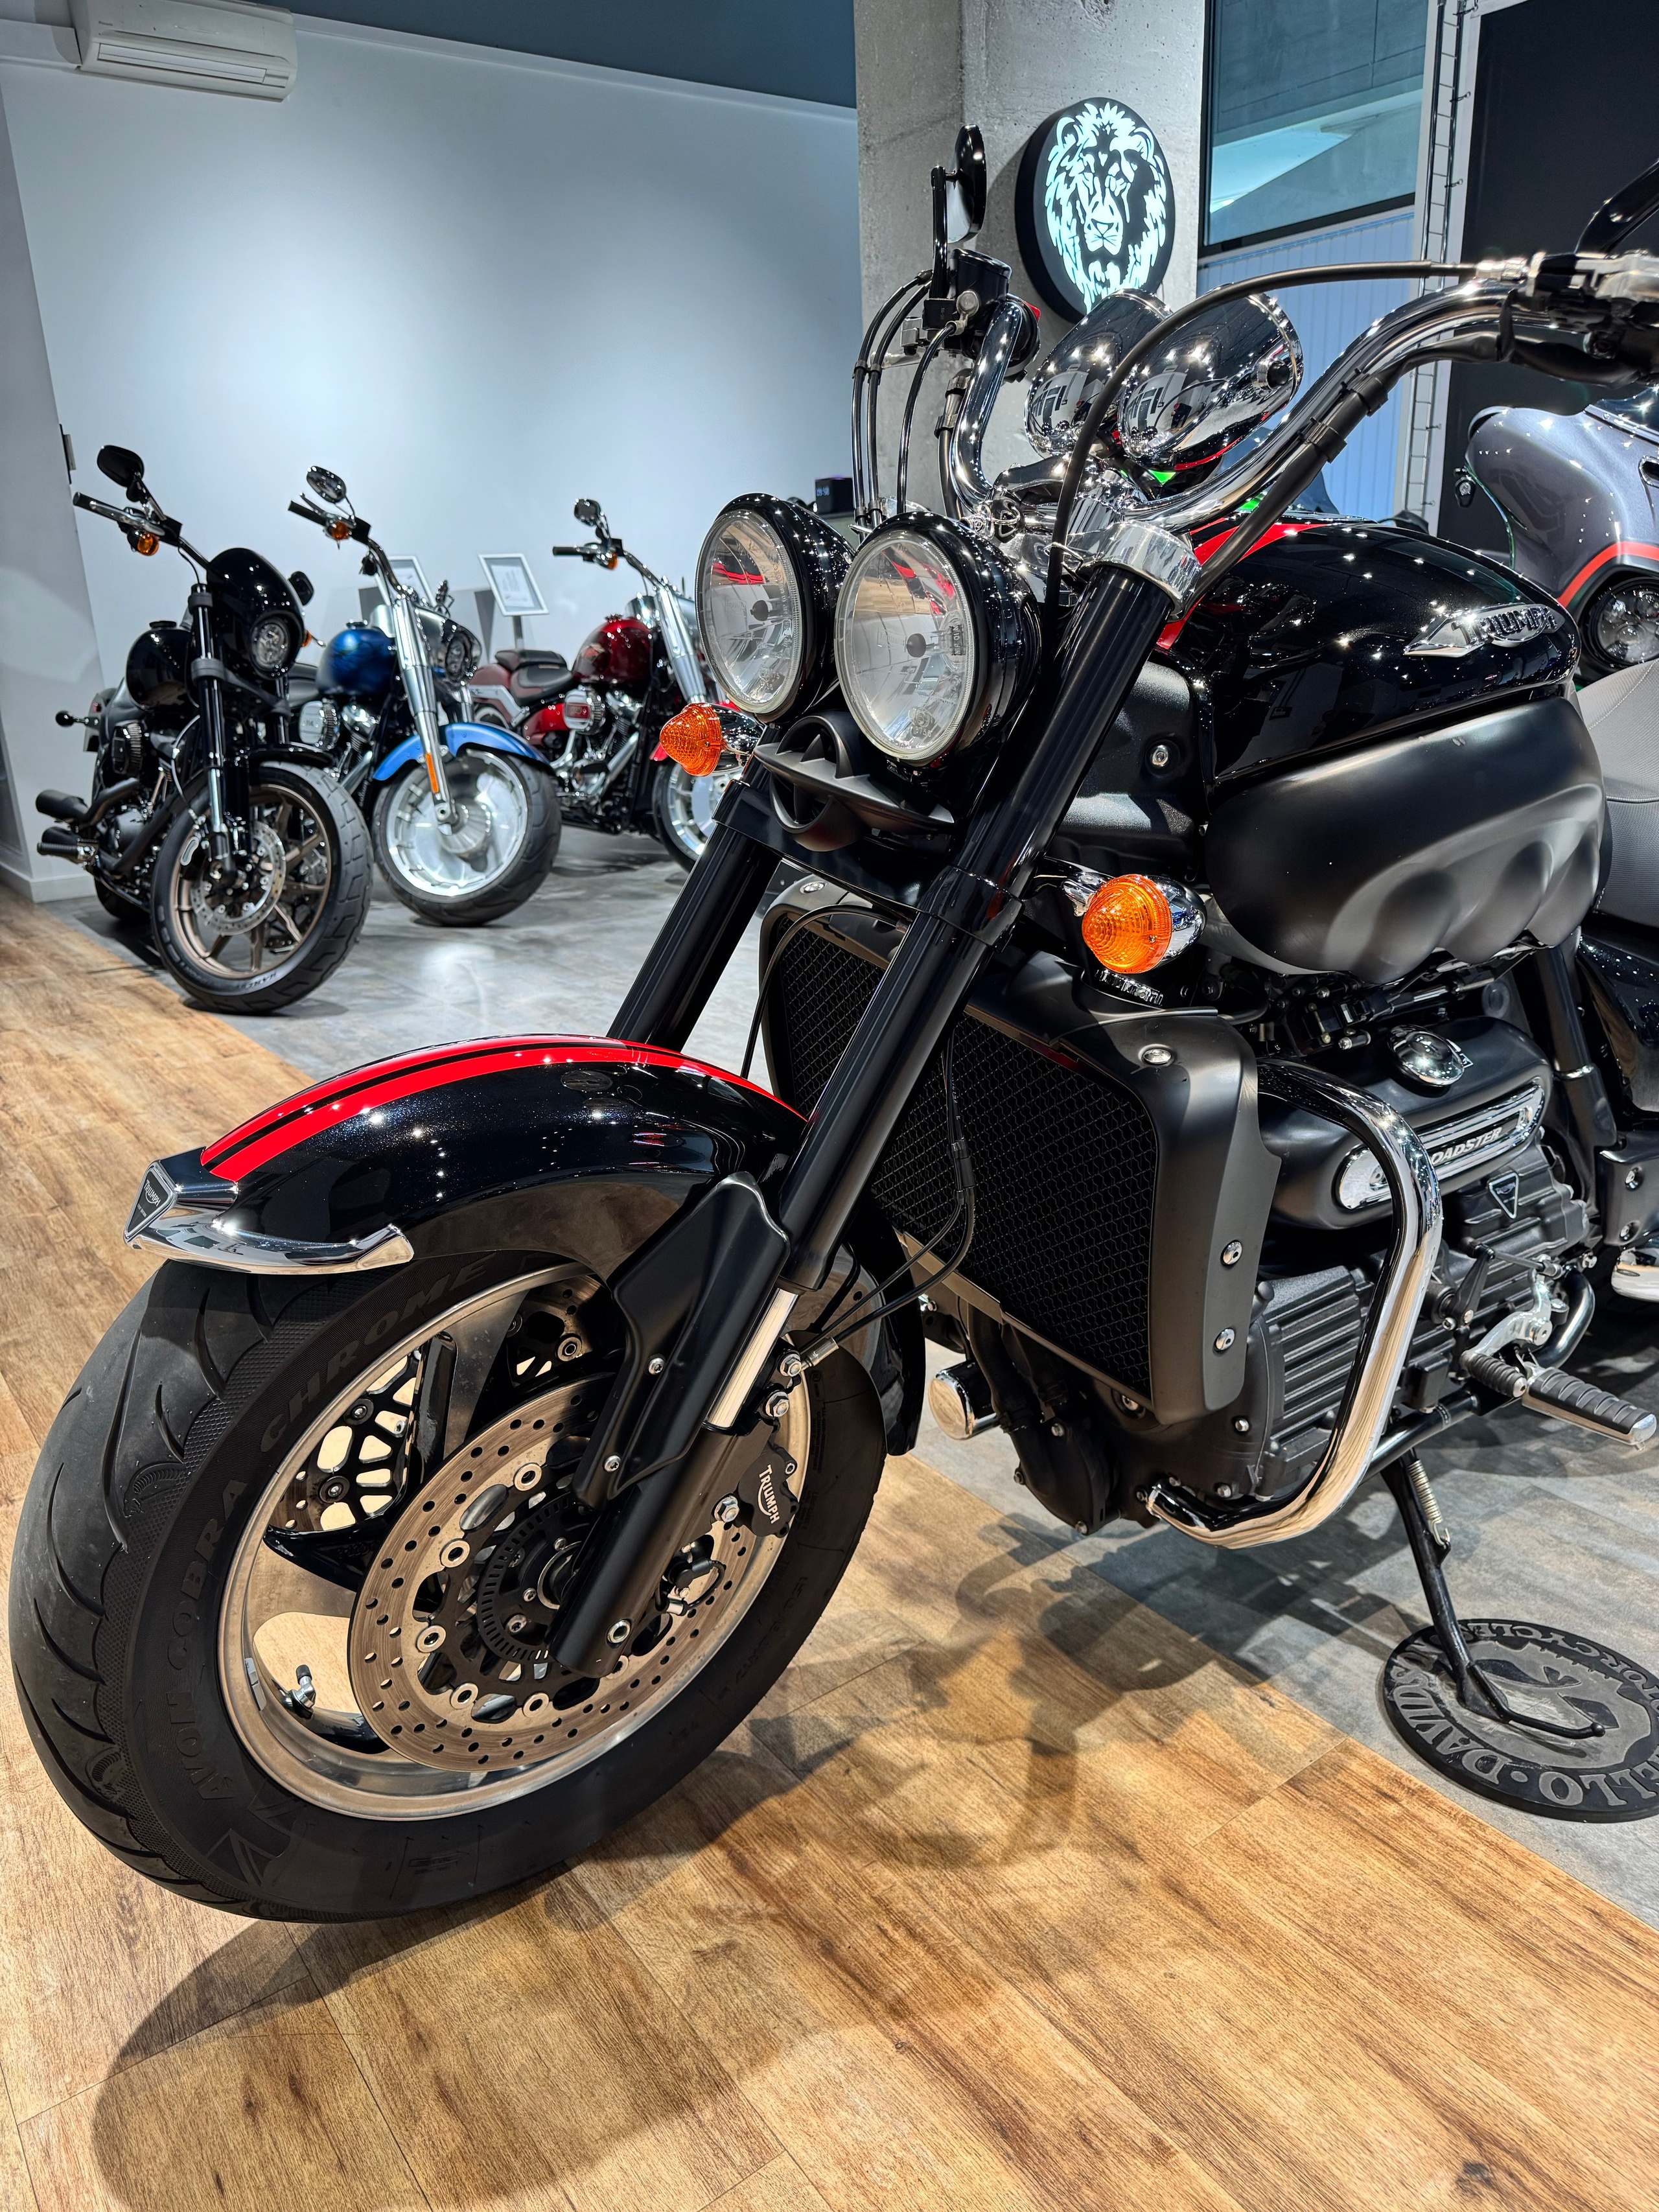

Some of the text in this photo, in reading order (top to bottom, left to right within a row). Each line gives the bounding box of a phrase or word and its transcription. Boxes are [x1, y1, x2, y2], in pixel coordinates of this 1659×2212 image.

[1451, 606, 1557, 646] TRIUMPH
[1430, 1126, 1503, 1166] OADSTER
[143, 1180, 161, 1207] TRIUMPH
[261, 1253, 496, 1452] CHROME
[758, 1464, 780, 1524] TRIUMPH
[167, 1480, 247, 1670] COBRA
[167, 1692, 235, 1800] AVON
[1538, 1745, 1659, 1806] ELLO
